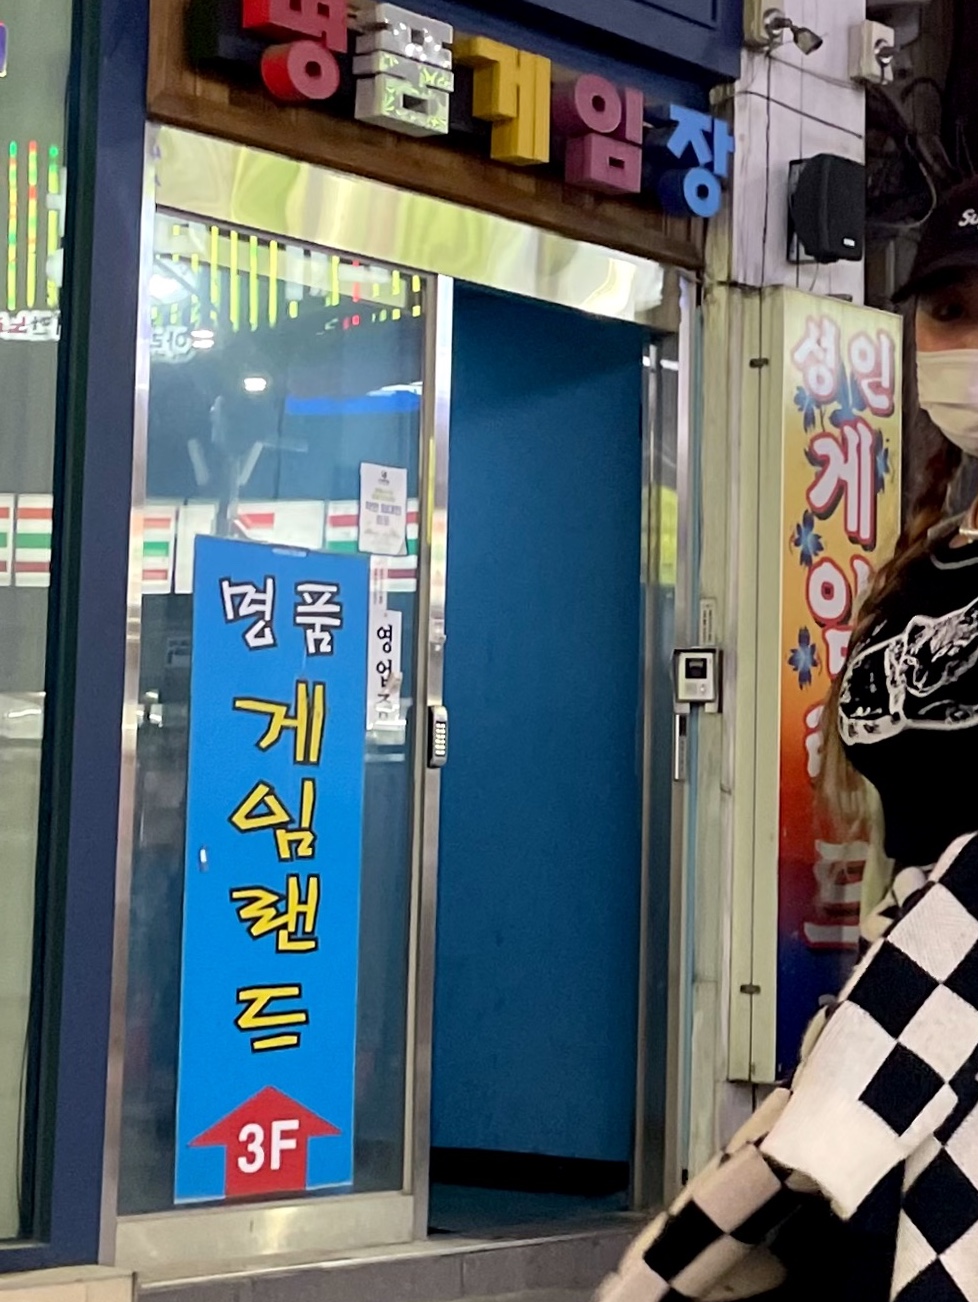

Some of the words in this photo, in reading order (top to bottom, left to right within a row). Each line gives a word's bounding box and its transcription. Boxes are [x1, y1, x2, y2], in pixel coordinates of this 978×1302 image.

[243, 0, 734, 218] 명품게임장
[792, 314, 896, 416] 성인
[220, 576, 343, 656] 명품
[230, 680, 325, 1051] 게임랜드
[237, 1119, 300, 1174] 3F
